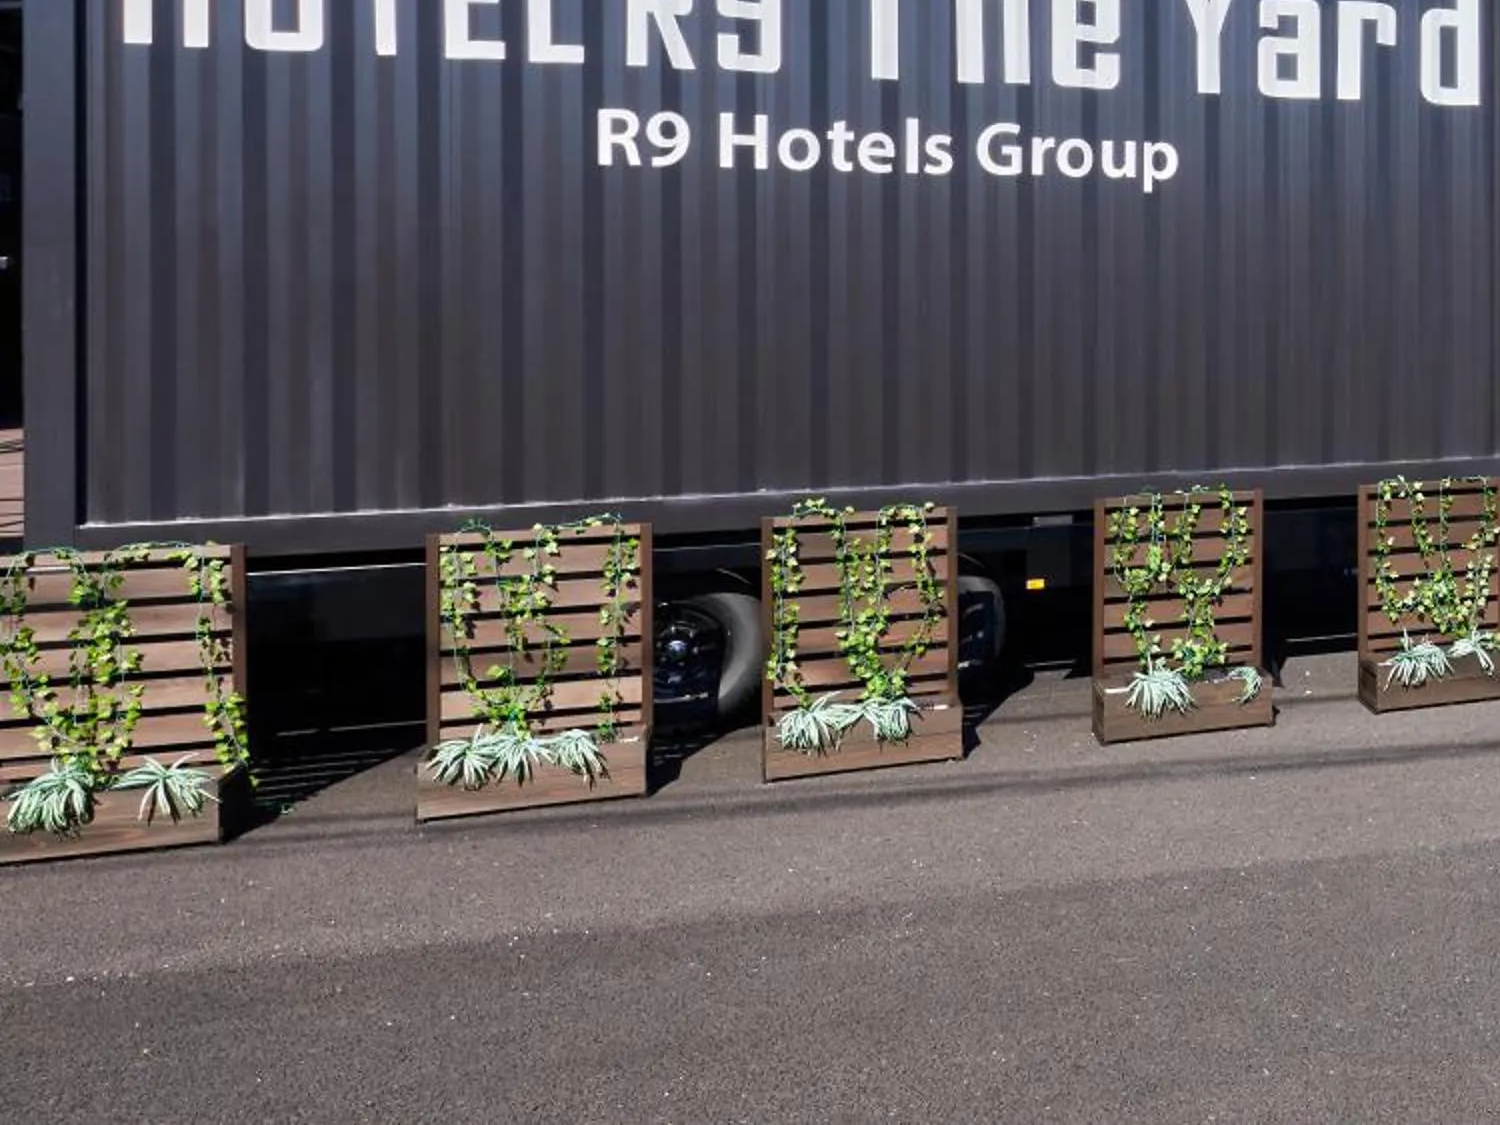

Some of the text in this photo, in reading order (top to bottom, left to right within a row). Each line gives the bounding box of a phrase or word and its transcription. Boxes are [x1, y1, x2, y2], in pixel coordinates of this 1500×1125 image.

[597, 108, 1179, 193] R9 Hotels Group
